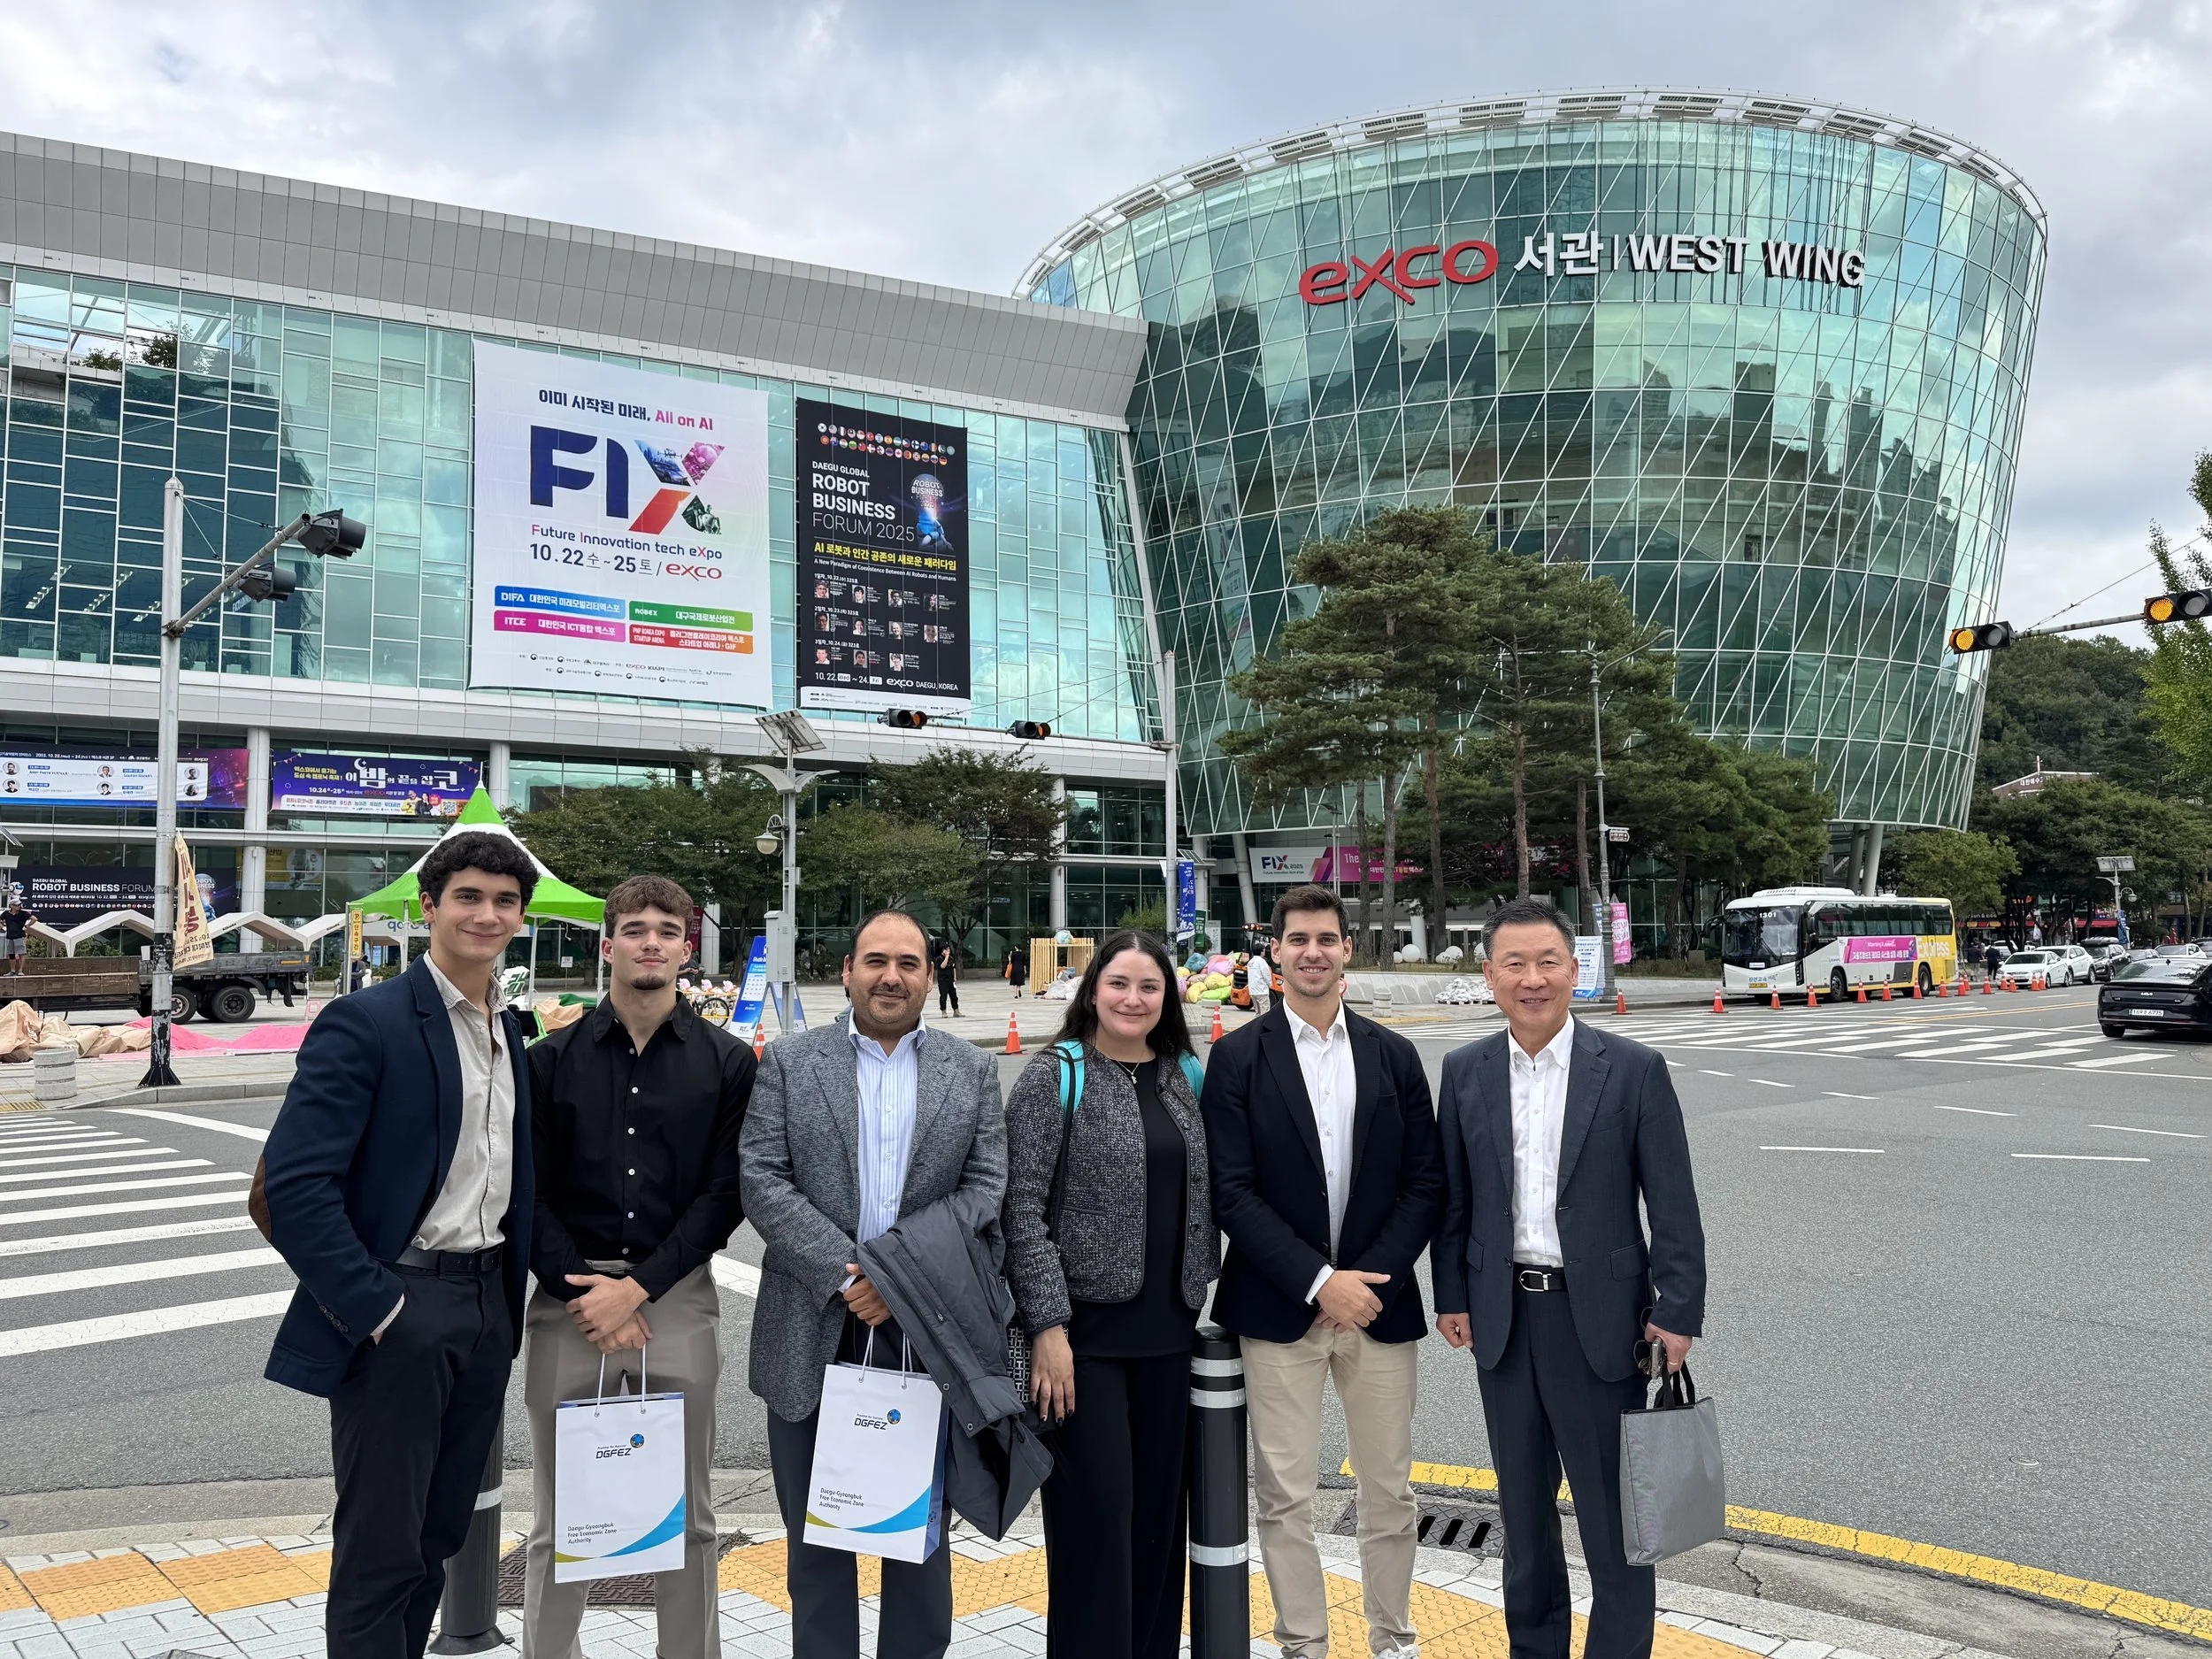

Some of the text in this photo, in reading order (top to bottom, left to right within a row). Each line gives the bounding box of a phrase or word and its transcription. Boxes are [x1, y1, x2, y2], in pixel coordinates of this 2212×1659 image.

[1514, 230, 1867, 287] 서관 WEST WING
[1297, 240, 1499, 305] exco
[539, 389, 713, 431] 이미 시작된 미래, All on AI
[812, 461, 870, 478] DAEGU GLOBAL
[530, 425, 726, 535] FIX
[812, 472, 870, 496] ROBOT
[912, 479, 941, 489] ROBOT
[910, 486, 943, 497] BUSINESS
[812, 492, 895, 520] BUSINESS
[813, 511, 915, 542] FORUM 2025
[531, 524, 723, 561] Future Innovation tech eXpo
[814, 541, 956, 571] AI 로봇과 인간 공존의 새로운 패러다임
[665, 563, 723, 581] exco
[830, 561, 851, 570] Paradigm
[857, 565, 885, 574] Coexistence
[501, 592, 526, 603] DIFA
[529, 594, 557, 605] 대한민국
[675, 611, 735, 625] 대구국제로봇산업전
[538, 618, 566, 630] 대한민국
[567, 622, 594, 634] ICT융합
[595, 626, 616, 636] 엑스포
[887, 678, 914, 688] exco
[1261, 855, 1289, 871] FIX
[1345, 853, 1359, 864] The
[854, 1417, 887, 1430] DGFEZ
[595, 1448, 632, 1459] DGFEZ
[819, 1502, 840, 1510] Authority
[830, 1496, 851, 1505] Economic
